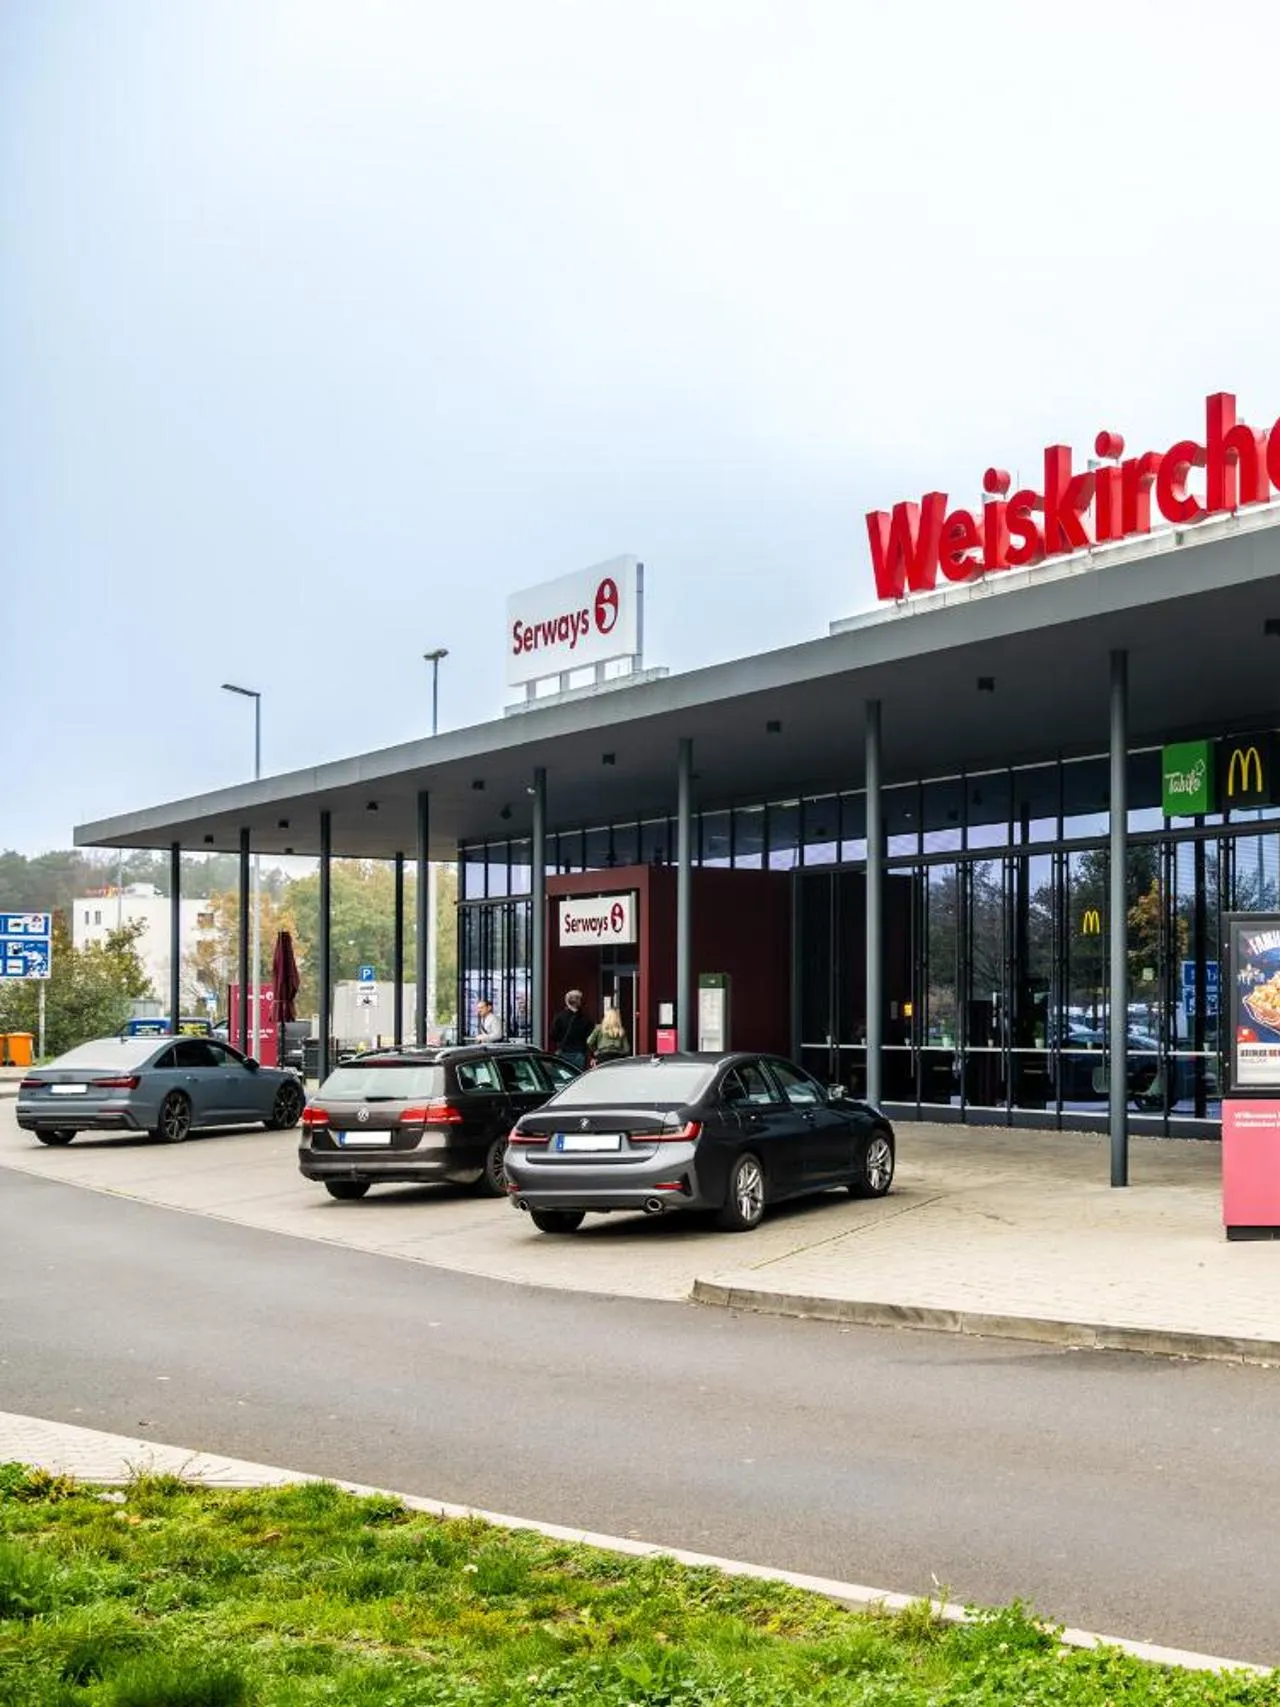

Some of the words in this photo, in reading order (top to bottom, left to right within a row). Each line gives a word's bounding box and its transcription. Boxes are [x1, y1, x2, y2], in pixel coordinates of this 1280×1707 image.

[512, 608, 591, 656] Serways
[564, 914, 609, 937] Serways
[363, 968, 372, 981] P
